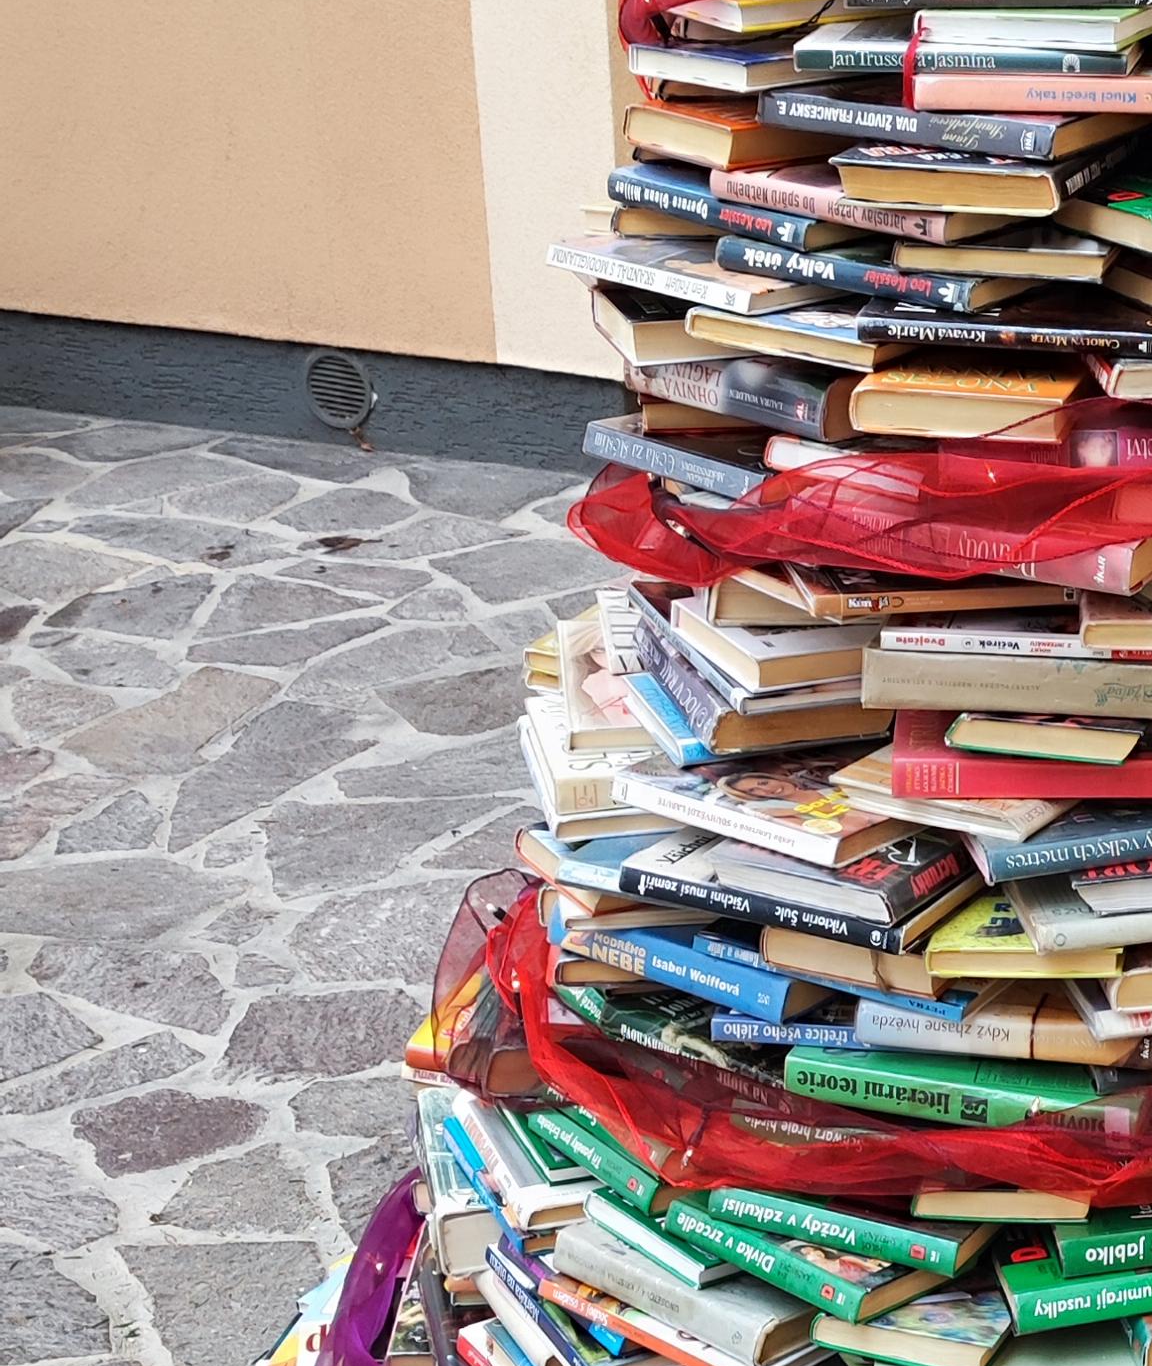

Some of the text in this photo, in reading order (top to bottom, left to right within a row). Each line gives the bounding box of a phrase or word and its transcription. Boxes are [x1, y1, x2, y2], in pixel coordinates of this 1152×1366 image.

[1026, 88, 1056, 103] taky
[1100, 90, 1137, 104] Kluci
[792, 103, 853, 125] FRANCESKY
[856, 111, 893, 131] ŽIVOTY
[896, 116, 917, 132] DVA
[641, 187, 670, 207] Glenn
[671, 196, 707, 220] Operace
[718, 208, 750, 229] Kessler
[752, 215, 772, 233] Leo
[742, 248, 781, 271] útěk
[784, 253, 836, 279] Velký
[864, 270, 907, 290] Kessler
[887, 325, 986, 343] Krvavá Marie
[1031, 332, 1120, 349] CAROLYN MEYER
[1005, 845, 1071, 870] metres
[1070, 834, 1141, 861] velkých
[681, 885, 799, 930] Šulc Všichni musí
[651, 954, 740, 996] Isabel Wolffová
[723, 1021, 848, 1046] třetice všeho zlého
[871, 1013, 1012, 1044] Když zhasne hvězda
[796, 1069, 951, 1117] literární teorie
[721, 1198, 857, 1244] Vraždy v zákulisí
[677, 1213, 776, 1274] Dívka v zrcadle
[1084, 1238, 1146, 1264] jablko
[1034, 1292, 1091, 1318] rusalky
[1096, 1284, 1152, 1312] umírají
